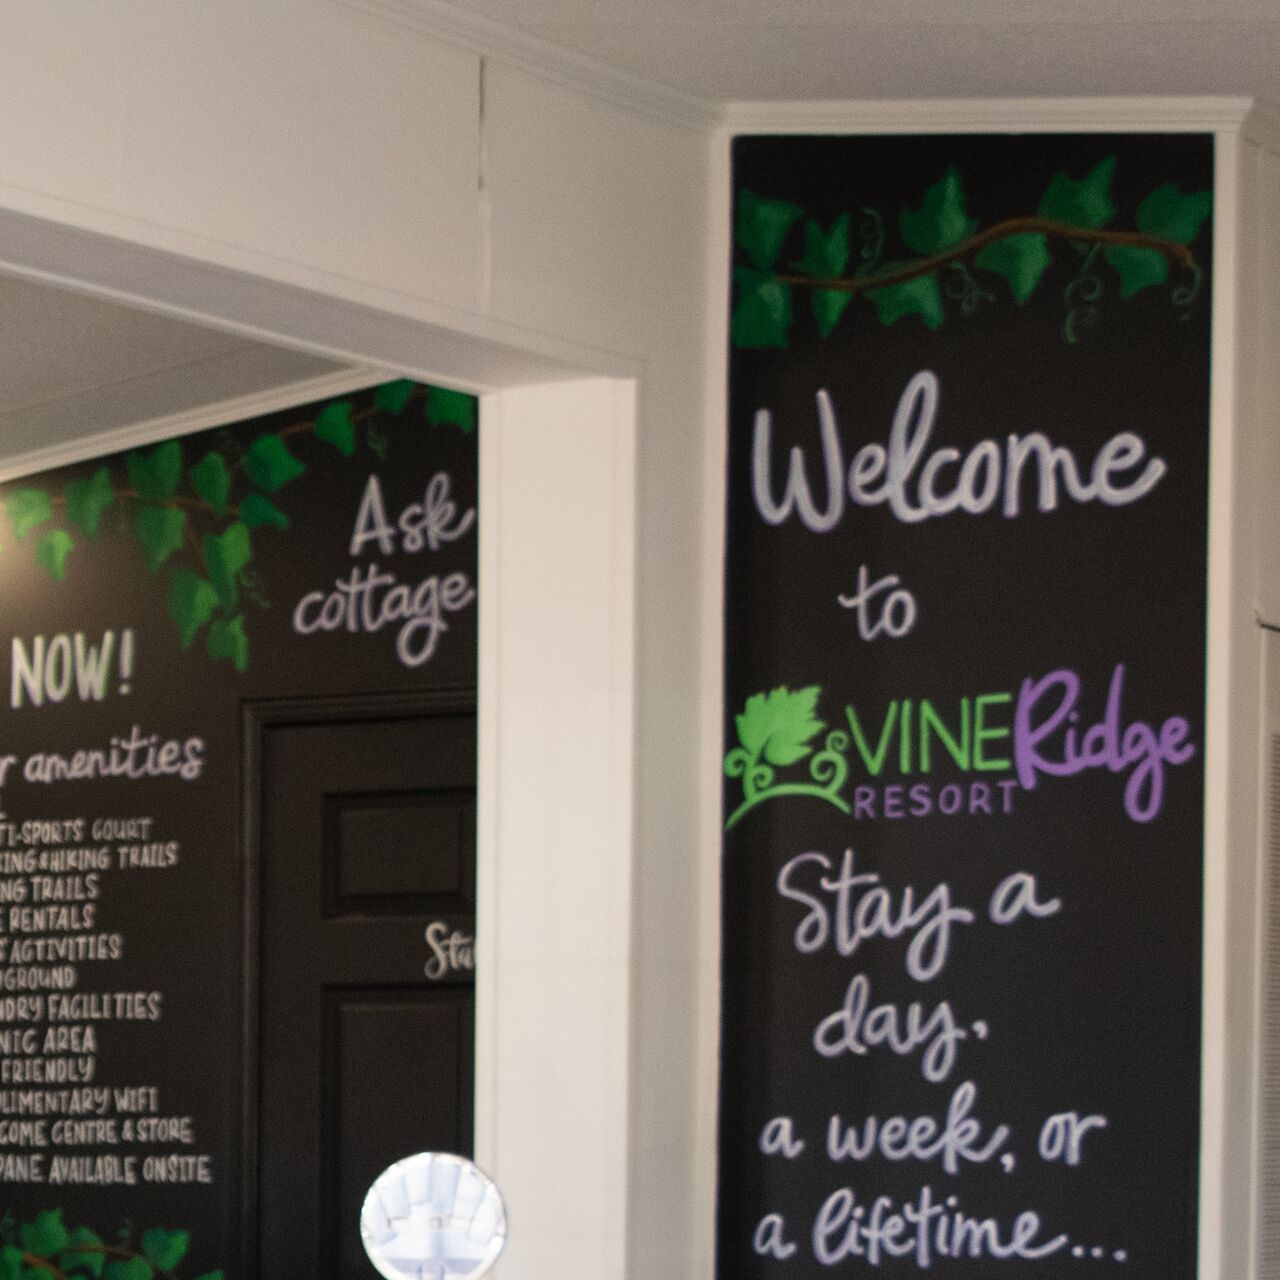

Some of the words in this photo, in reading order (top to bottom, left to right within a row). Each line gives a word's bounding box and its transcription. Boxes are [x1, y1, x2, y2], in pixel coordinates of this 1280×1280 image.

[751, 370, 1168, 532] Welcome
[349, 470, 476, 558] Ask
[294, 563, 475, 668] cottage
[838, 566, 917, 641] to
[11, 628, 135, 709] NOW!
[23, 724, 207, 781] amenities
[852, 779, 1019, 820] RESORT
[92, 819, 151, 839] COURT
[51, 849, 110, 870] HIKING
[118, 843, 177, 866] TRAILS
[30, 875, 98, 900] TRAILS
[9, 905, 94, 931] RENTALS
[777, 848, 975, 981] Stay
[990, 870, 1061, 927] a
[47, 993, 161, 1019] FACILITIES
[42, 1027, 96, 1052] AREA
[1, 1058, 94, 1082] FRIENDLY
[113, 1087, 157, 1111] WIFI
[51, 1120, 117, 1143] CENTRE
[136, 1118, 192, 1142] STORE
[759, 1116, 805, 1157] a
[826, 1080, 1017, 1176] week,
[1038, 1111, 1108, 1167] or
[48, 1156, 136, 1183] AVAILABLE
[142, 1155, 211, 1182] ONSITE
[752, 1211, 796, 1260] a
[812, 1186, 1129, 1268] lifetime...
